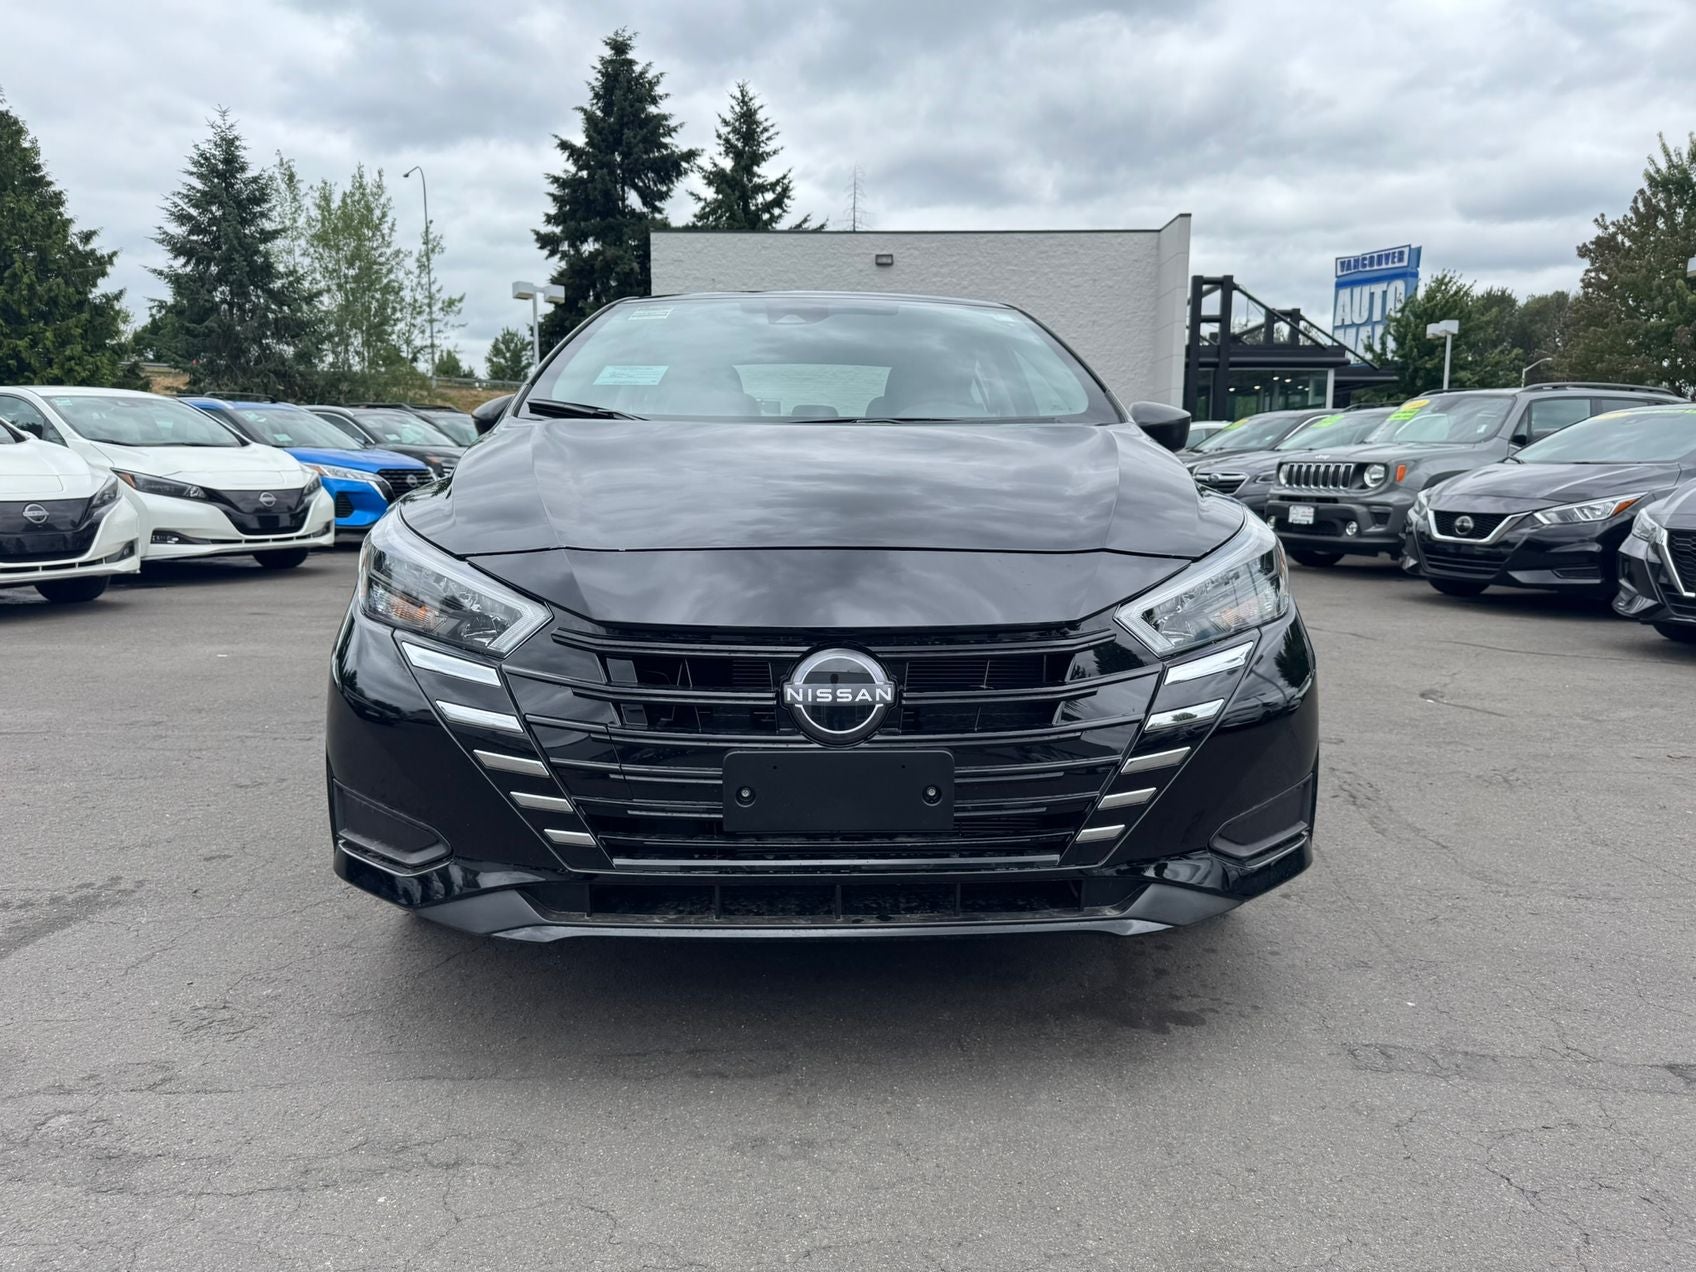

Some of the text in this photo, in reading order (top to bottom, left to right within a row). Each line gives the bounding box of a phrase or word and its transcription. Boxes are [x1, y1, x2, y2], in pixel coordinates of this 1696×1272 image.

[1339, 250, 1405, 273] VANCOUVER
[1334, 279, 1406, 326] AUTO
[786, 688, 892, 702] NISSAN
